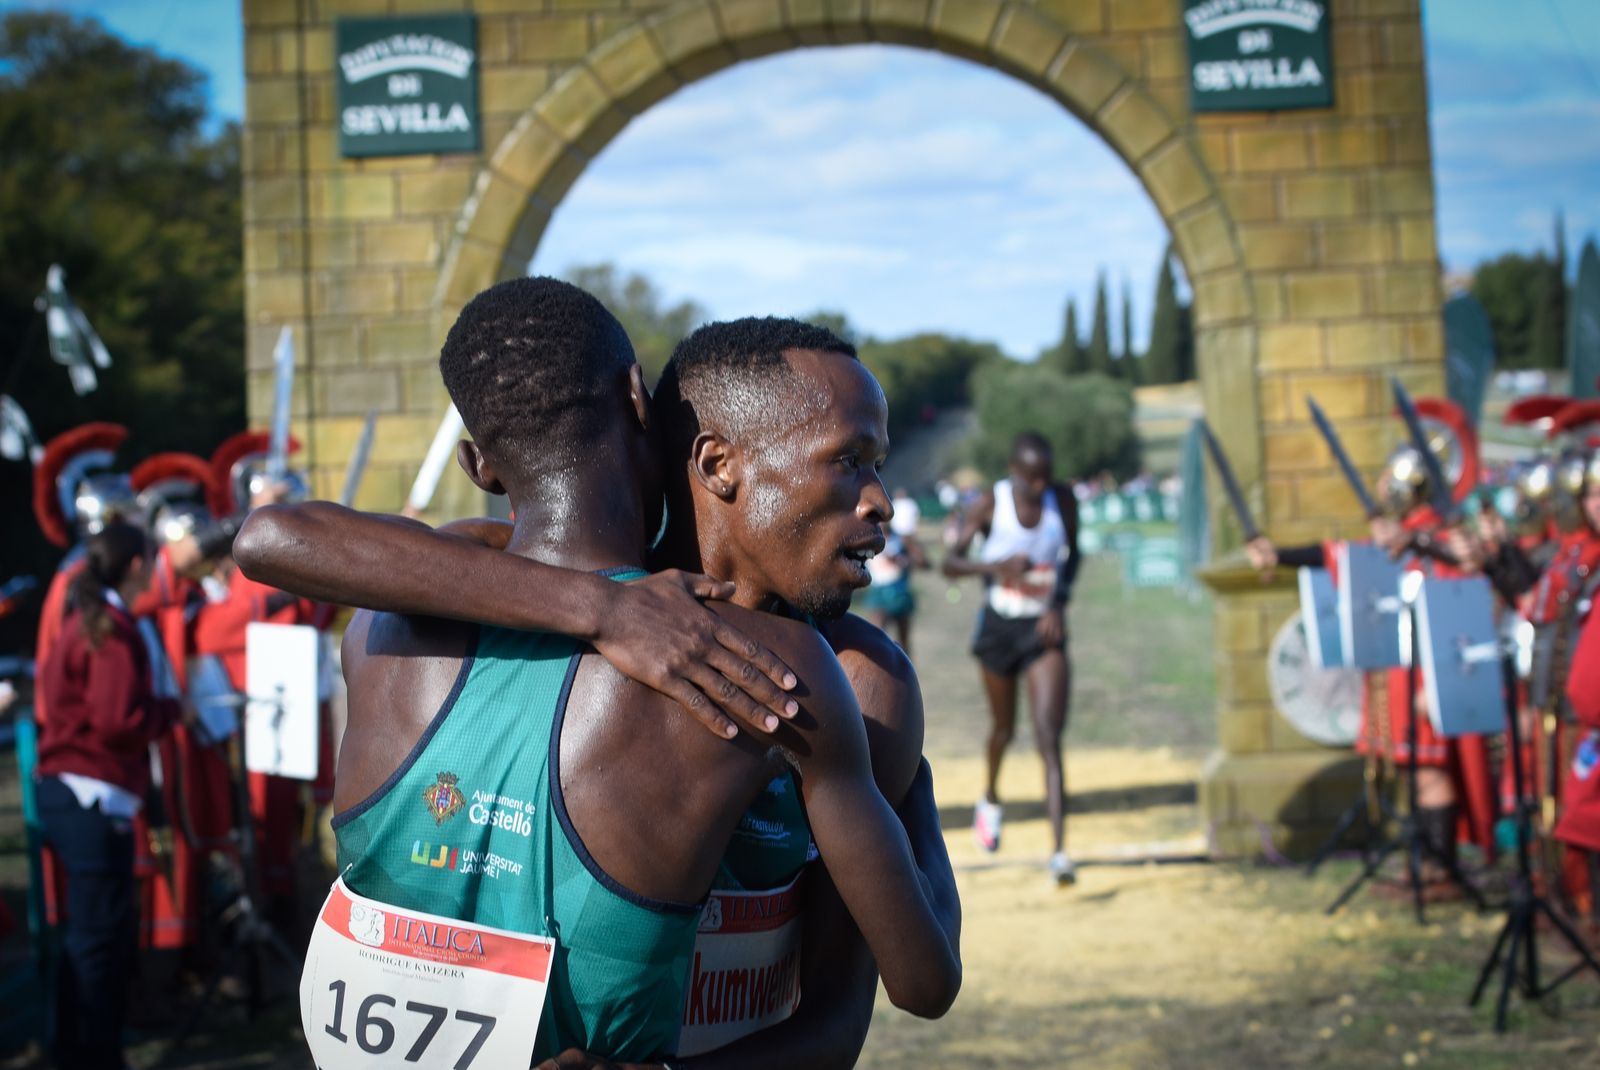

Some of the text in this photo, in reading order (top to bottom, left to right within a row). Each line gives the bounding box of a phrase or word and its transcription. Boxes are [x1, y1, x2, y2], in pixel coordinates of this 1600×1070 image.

[1193, 57, 1323, 92] SEVILLA
[342, 103, 470, 136] SEVILLA
[471, 789, 535, 815] Ajuntament de
[469, 803, 532, 837] Castelló
[459, 862, 495, 878] JAUME
[463, 849, 523, 876] UNIVERSITAT
[392, 916, 485, 956] ITALICA
[358, 949, 412, 969] RODRIGUE
[414, 963, 465, 979] KWIZERA
[324, 979, 497, 1070] 1677
